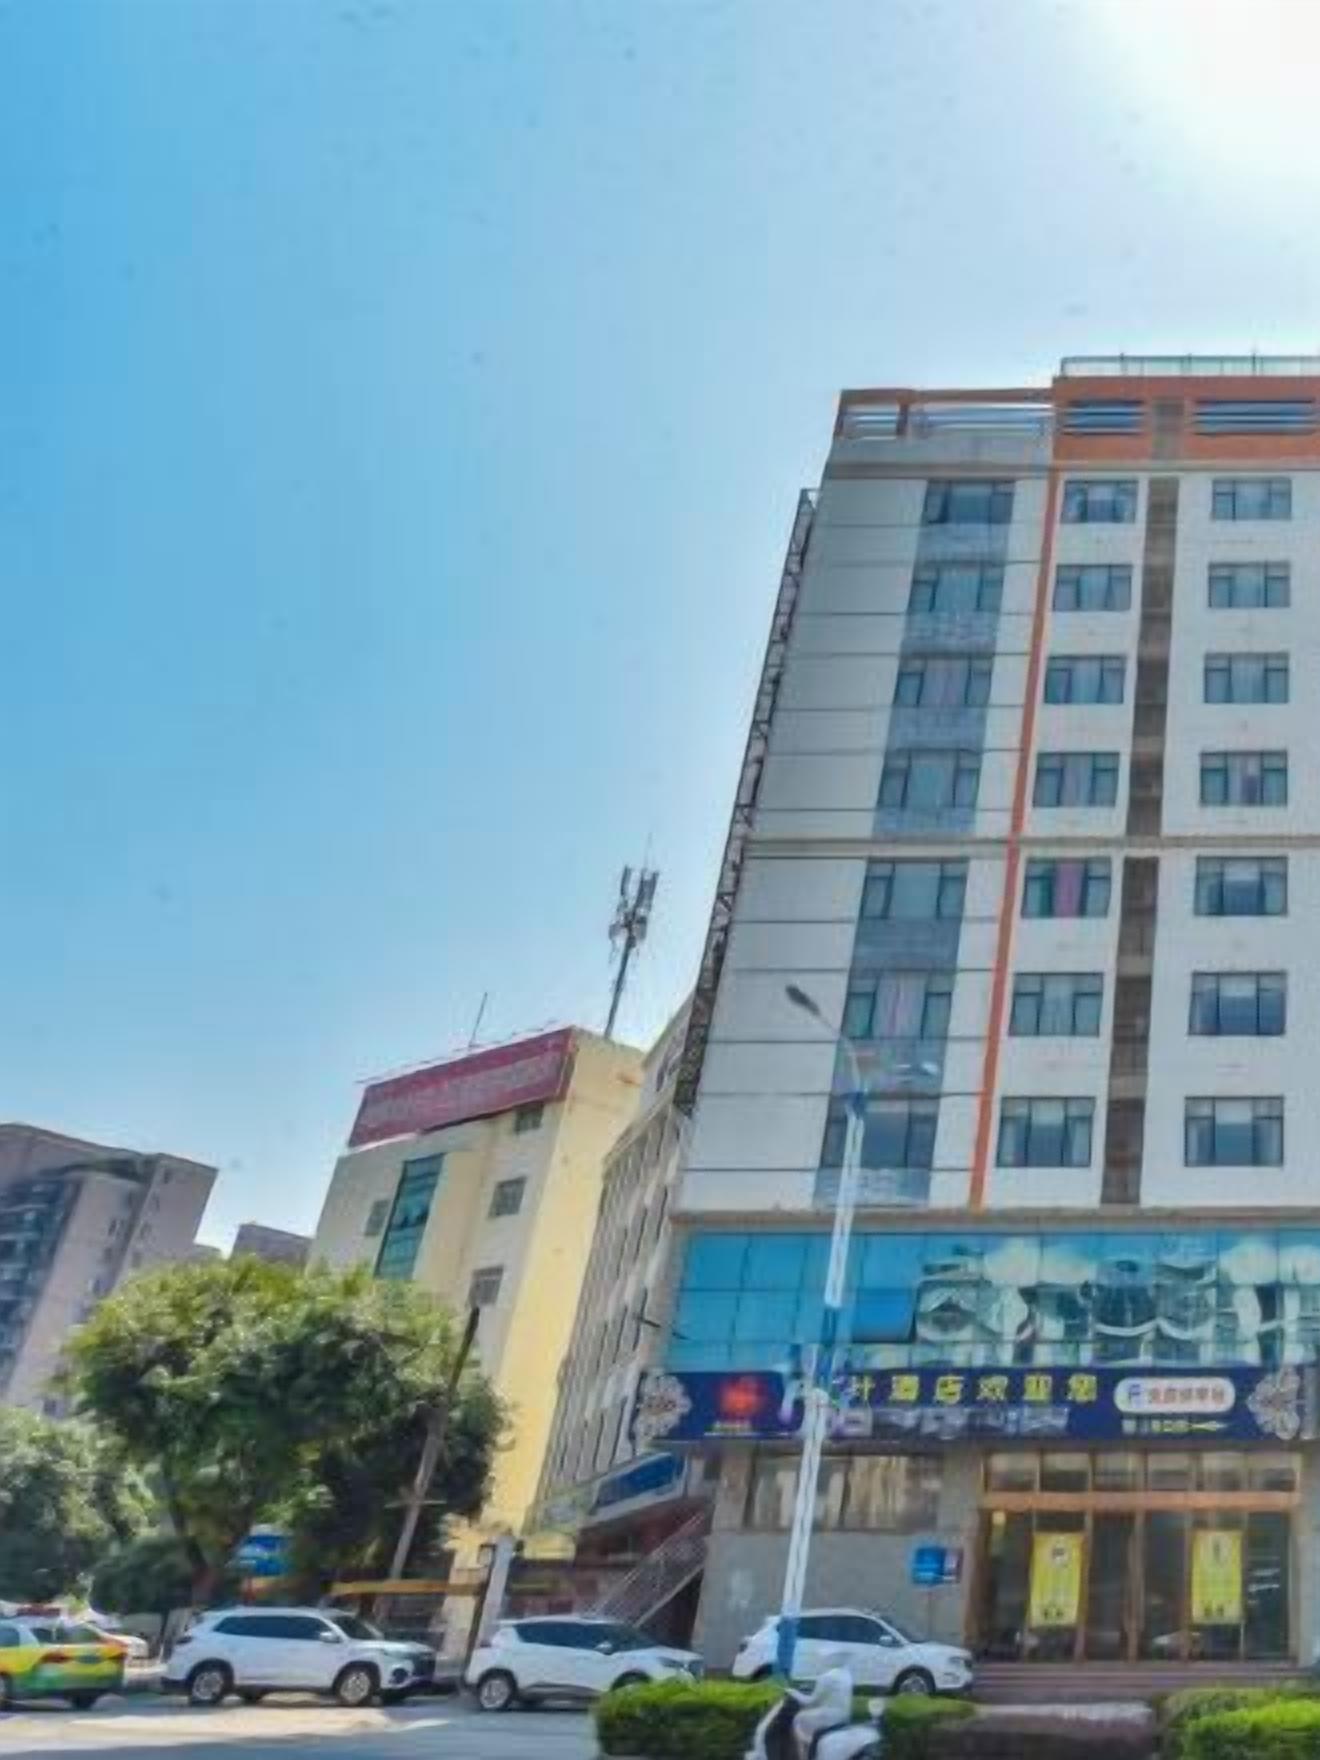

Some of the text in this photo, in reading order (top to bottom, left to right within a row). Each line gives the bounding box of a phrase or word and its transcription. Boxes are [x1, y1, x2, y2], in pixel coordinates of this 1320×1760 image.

[802, 1375, 1097, 1405] 叶酒店欢迎您
